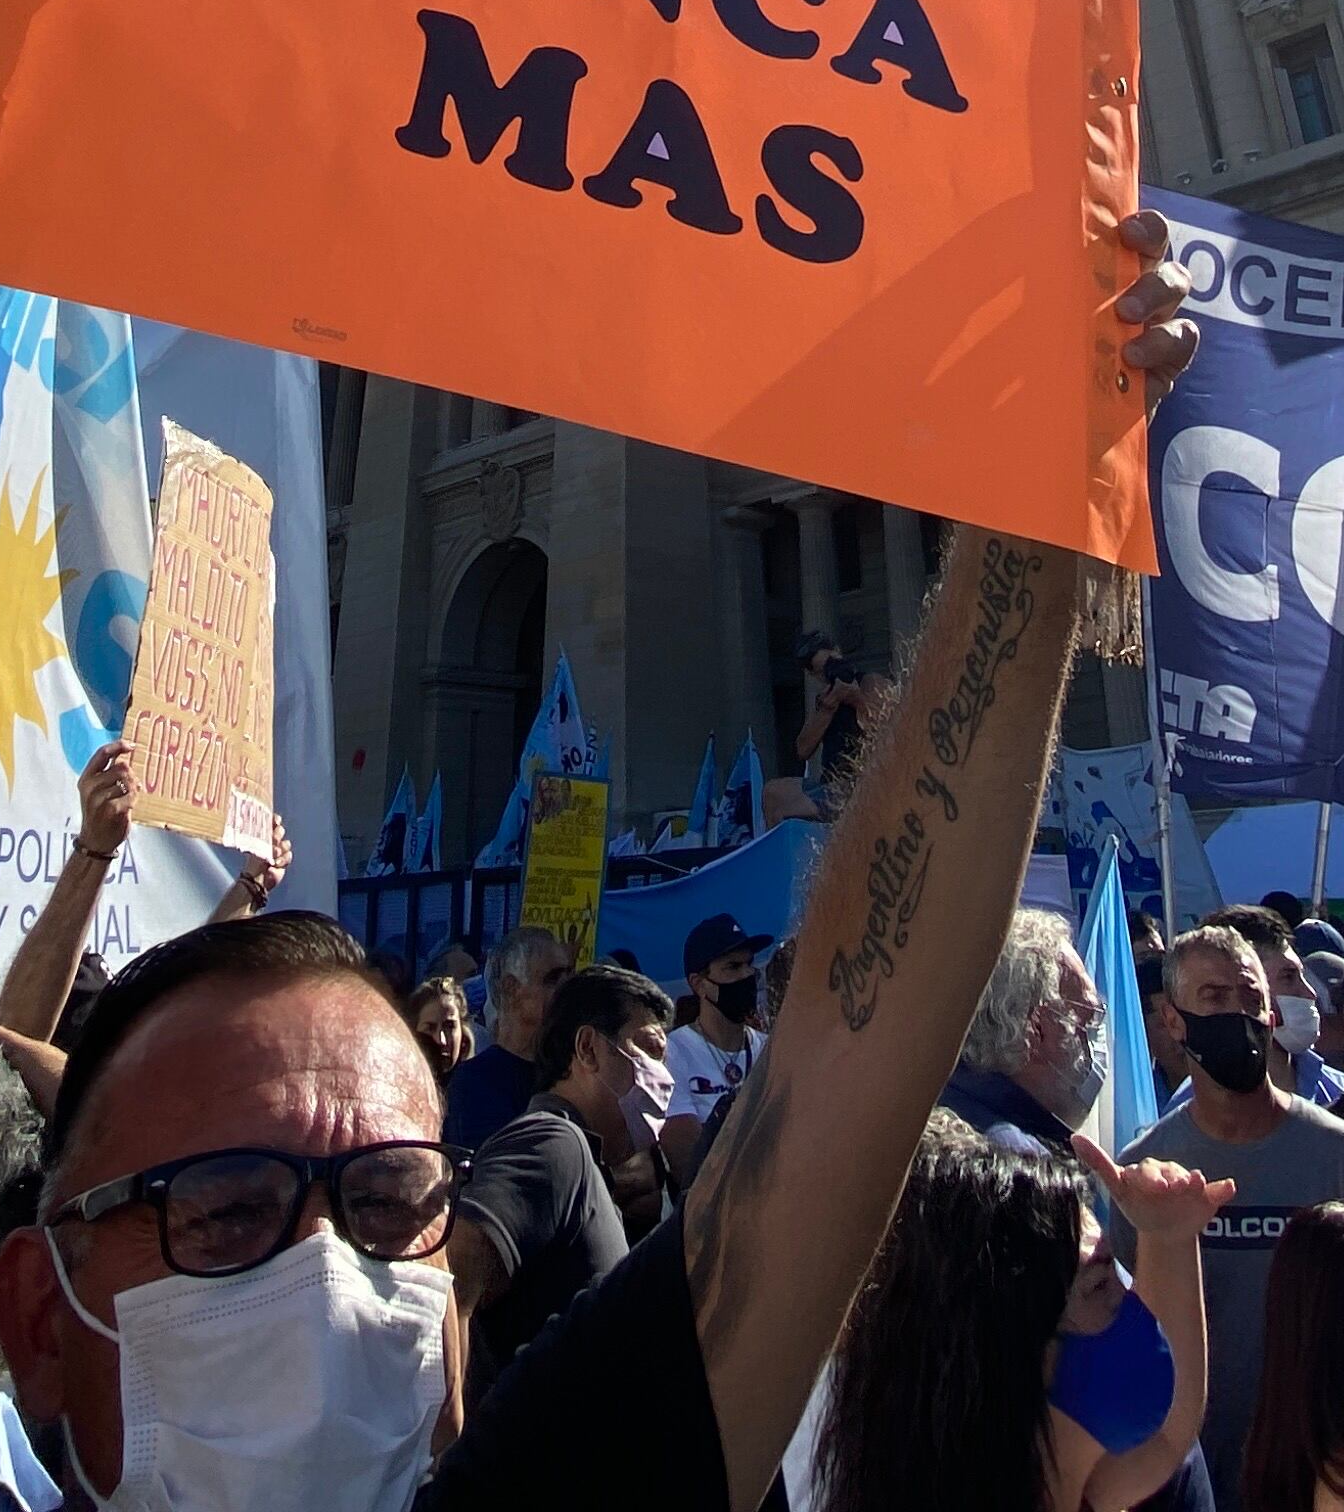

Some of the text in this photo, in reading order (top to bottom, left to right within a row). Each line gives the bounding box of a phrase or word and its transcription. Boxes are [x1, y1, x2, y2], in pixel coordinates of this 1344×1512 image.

[394, 9, 864, 263] MAS
[152, 535, 248, 647] MALDITO
[829, 809, 926, 1031] Argentino
[915, 766, 959, 821] y
[1202, 1217, 1293, 1238] OLCO
